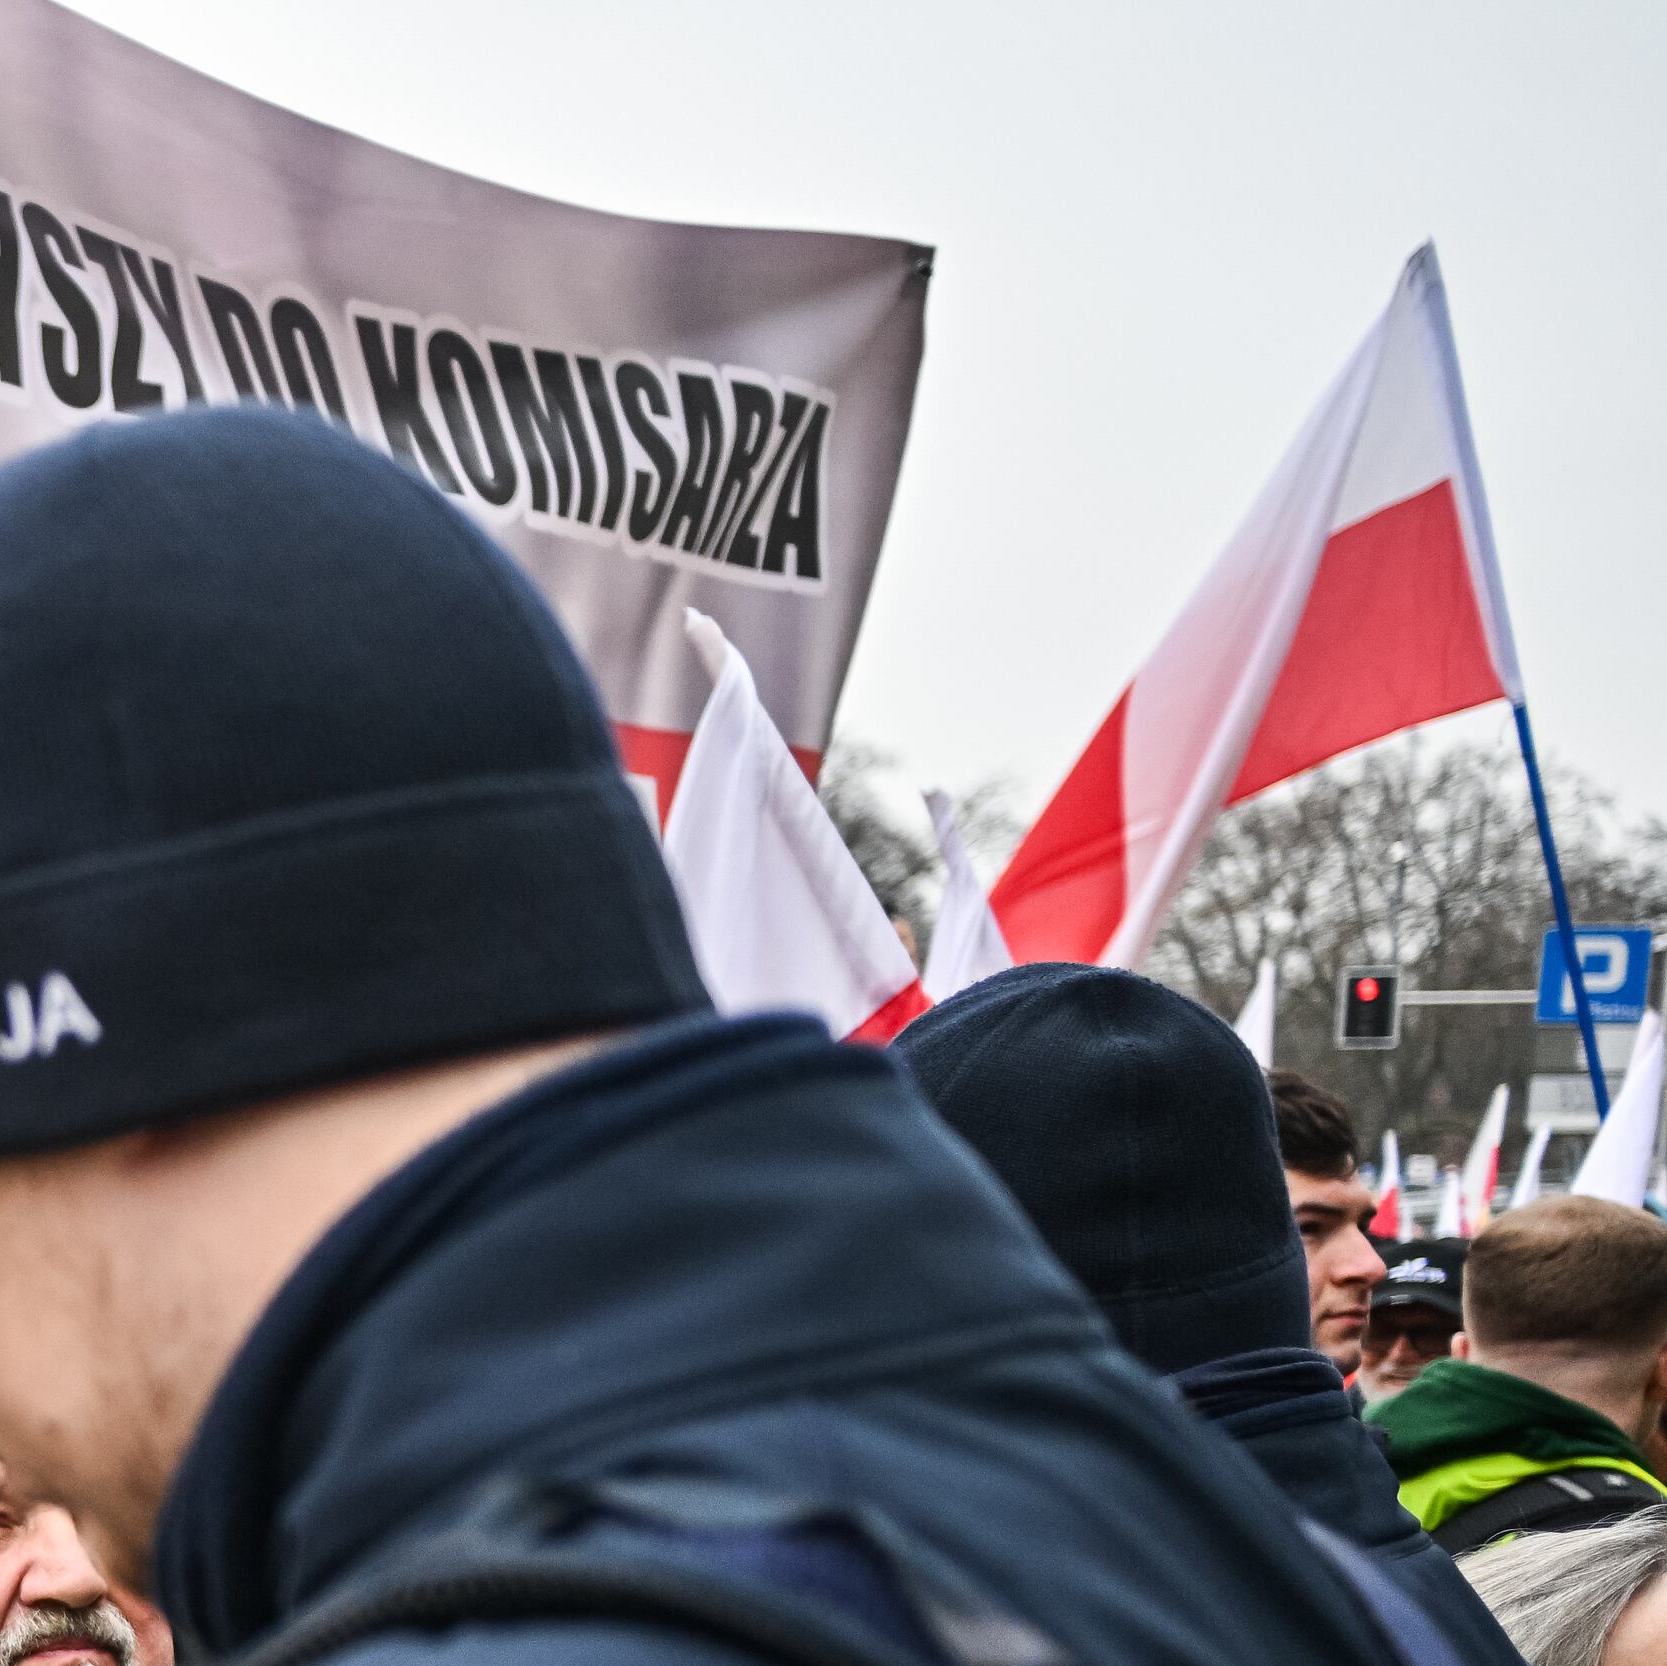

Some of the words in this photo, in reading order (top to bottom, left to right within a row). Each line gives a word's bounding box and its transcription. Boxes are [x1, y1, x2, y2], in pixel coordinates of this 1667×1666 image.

[197, 276, 351, 422] DO
[354, 315, 831, 581] KOMISARZA
[1562, 934, 1629, 1015] P
